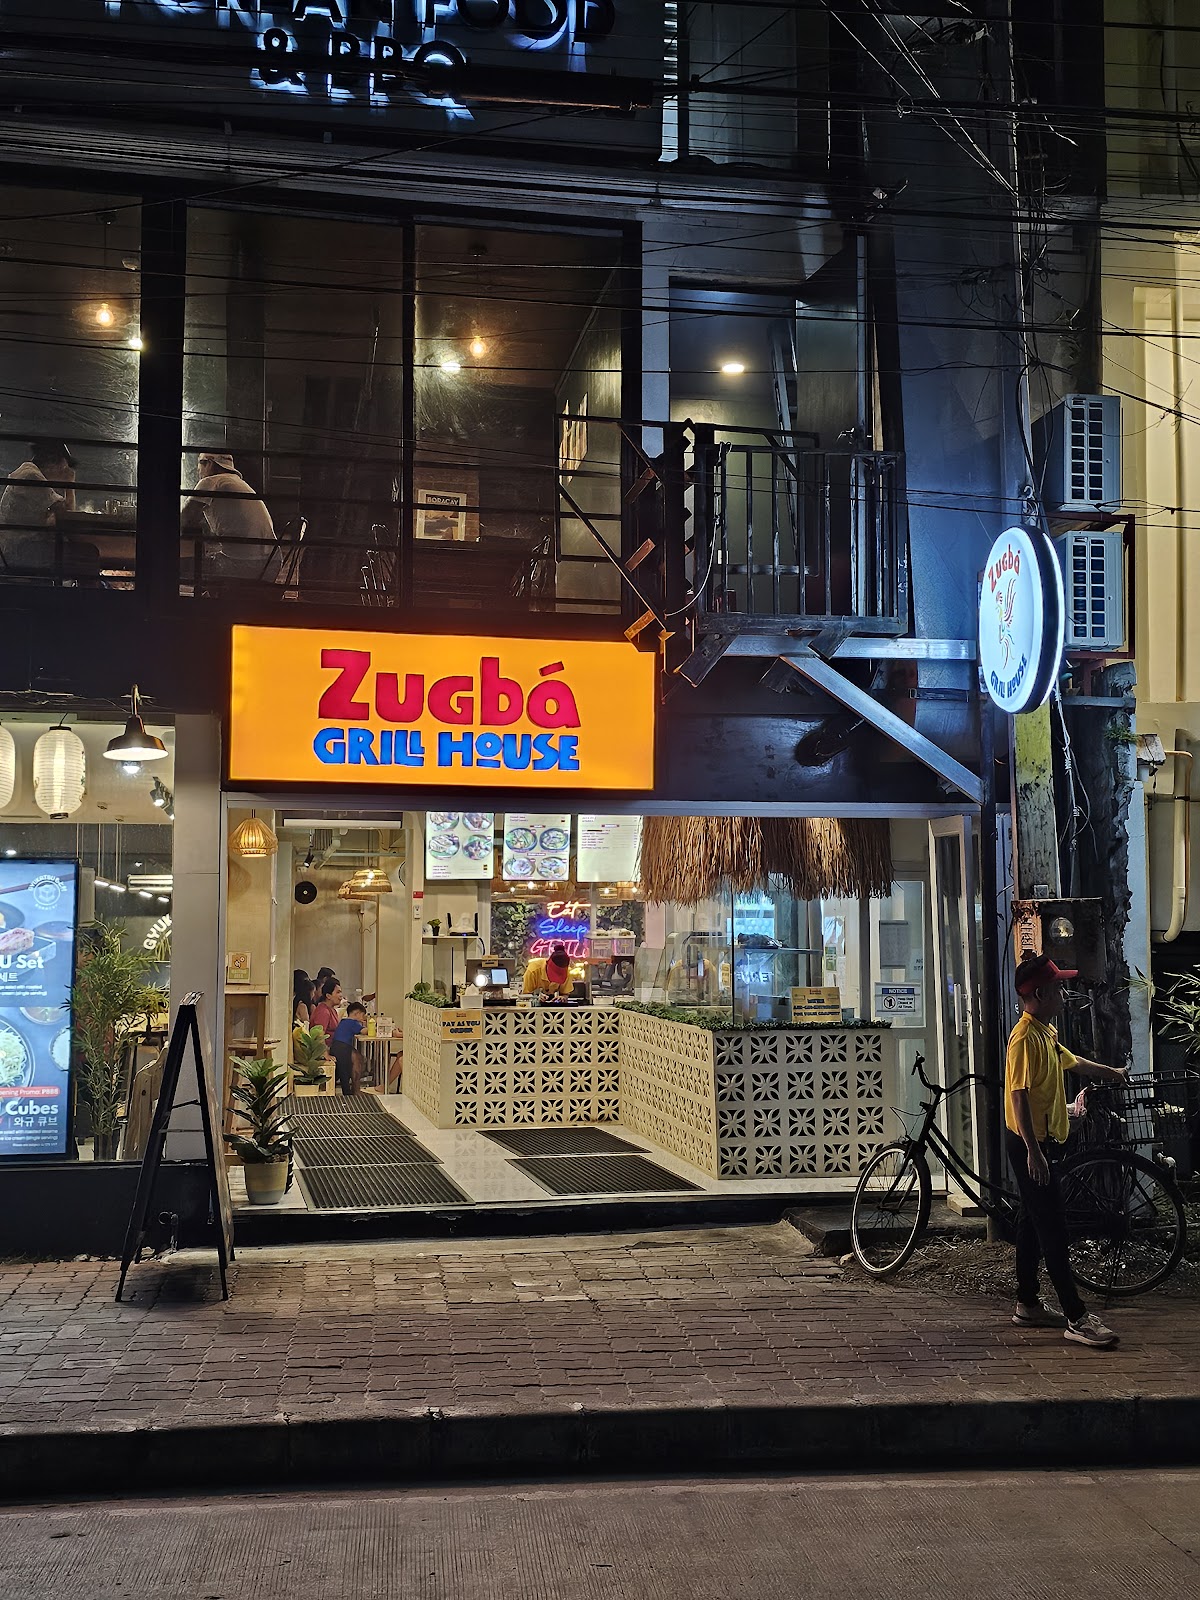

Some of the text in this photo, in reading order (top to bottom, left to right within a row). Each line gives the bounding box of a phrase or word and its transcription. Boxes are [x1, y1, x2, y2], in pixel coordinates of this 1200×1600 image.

[990, 653, 1028, 699] GRILL HOUSE
[313, 727, 580, 770] GRILL HOUSE
[547, 901, 591, 918] Eat
[540, 918, 588, 940] Sleep
[16, 954, 44, 969] Set
[5, 1100, 59, 1116] Cubes
[13, 1117, 58, 1127] 와규 큐브
